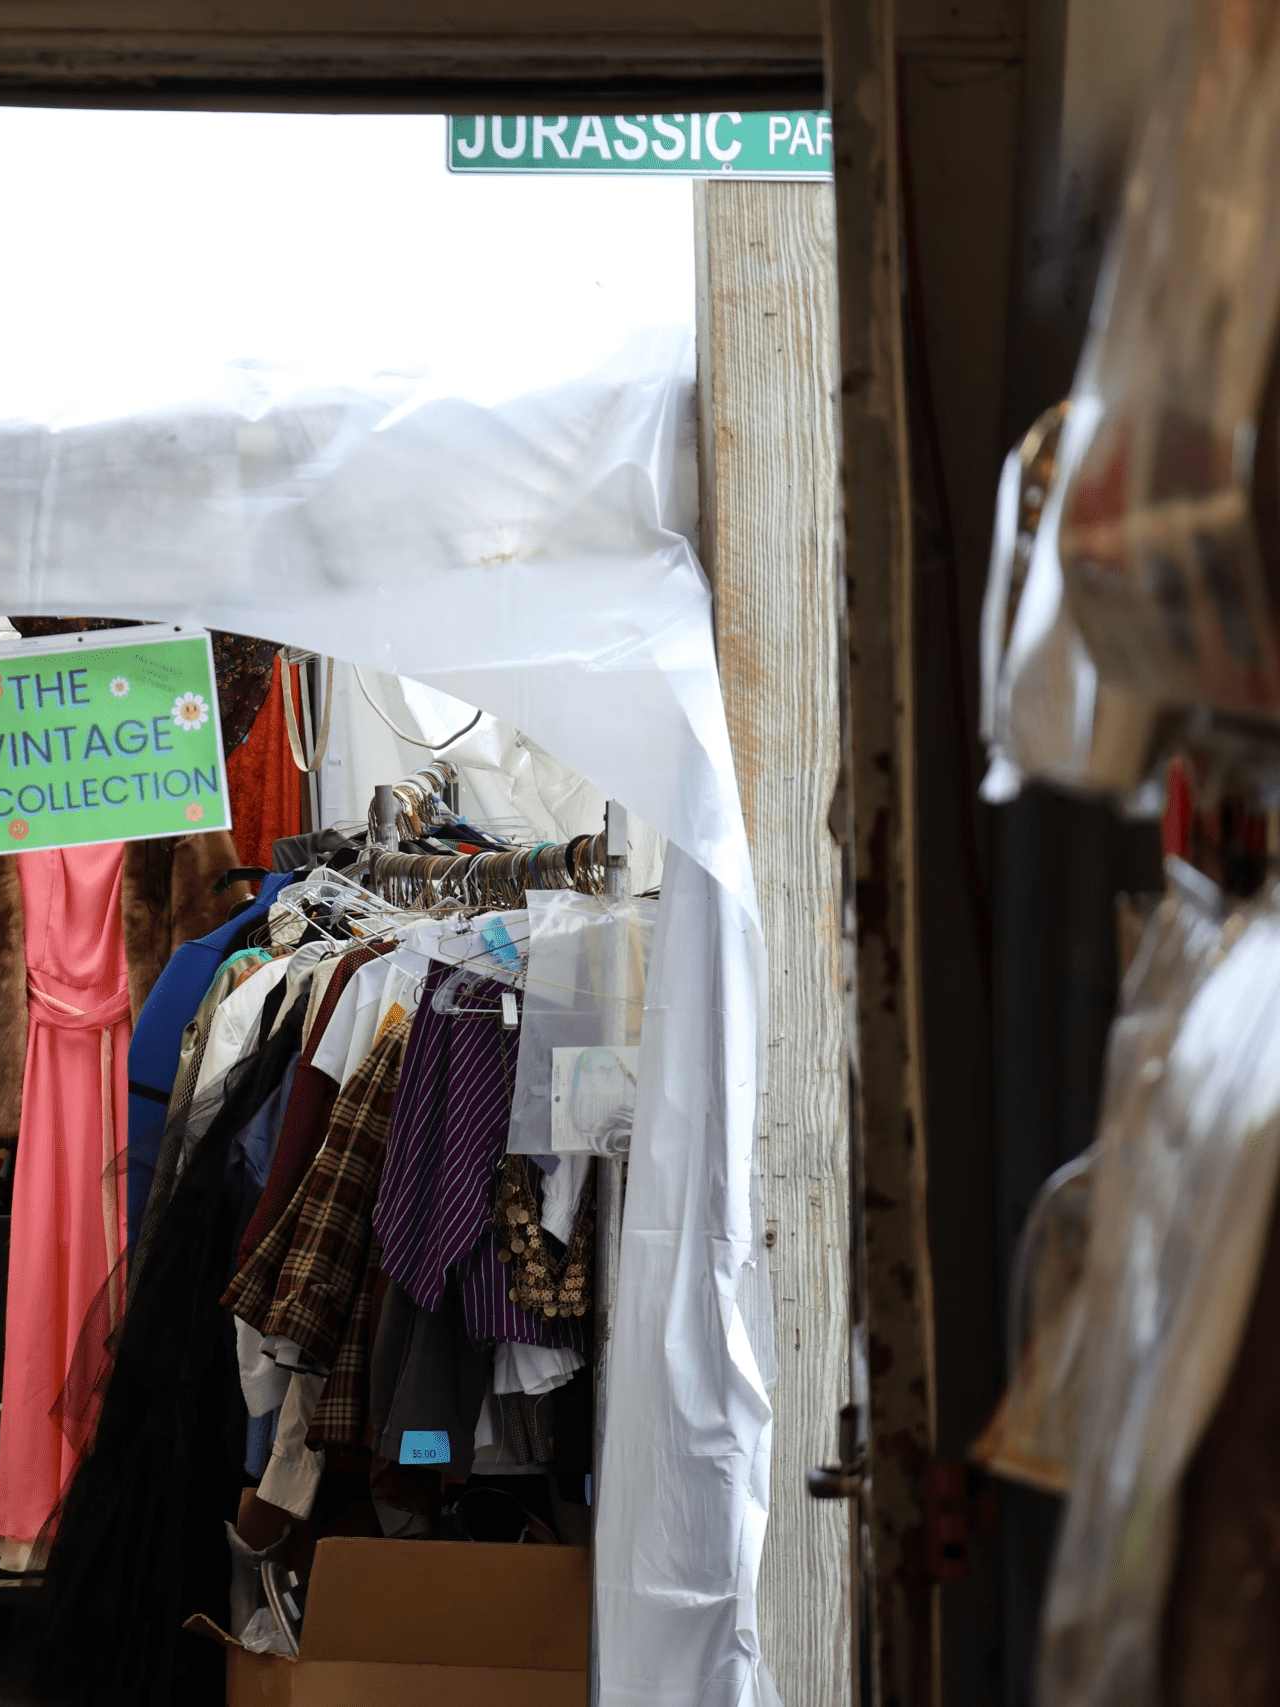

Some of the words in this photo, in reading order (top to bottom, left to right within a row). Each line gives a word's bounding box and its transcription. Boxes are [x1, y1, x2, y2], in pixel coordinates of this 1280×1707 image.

[457, 112, 742, 161] JURASSIC
[6, 668, 90, 713] THE
[412, 1449, 437, 1459] $5.00
